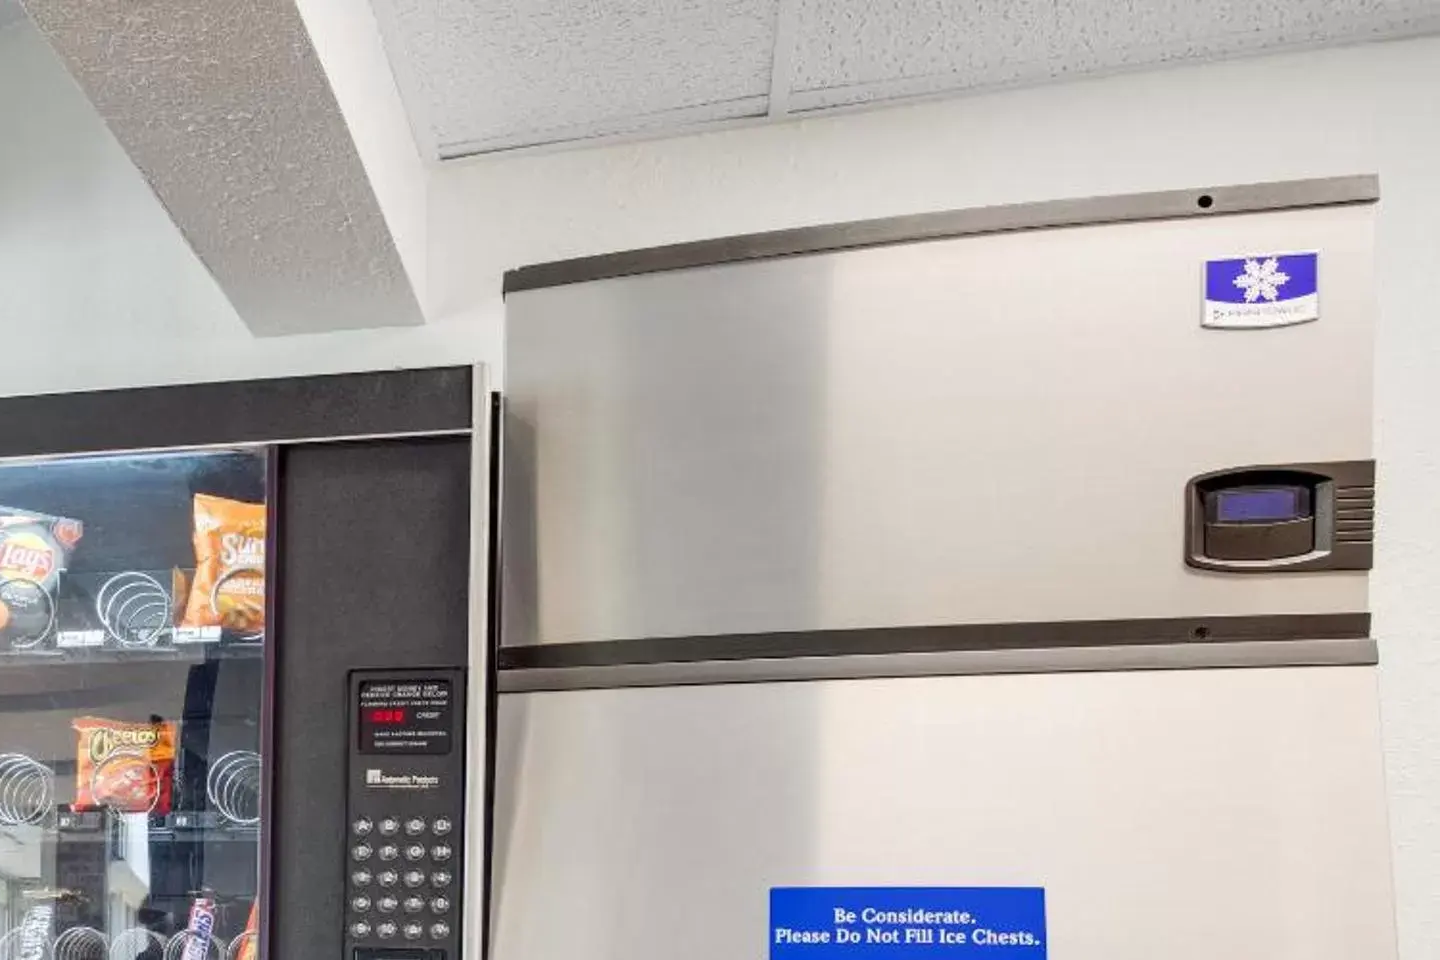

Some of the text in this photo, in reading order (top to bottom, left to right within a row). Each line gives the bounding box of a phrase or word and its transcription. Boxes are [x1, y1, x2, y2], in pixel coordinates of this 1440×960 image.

[2, 544, 53, 574] Lay's
[89, 728, 159, 764] Cheetos
[833, 908, 977, 925] Be Considerate.
[774, 928, 1041, 946] Please Do Not Fill Ice Chests.
